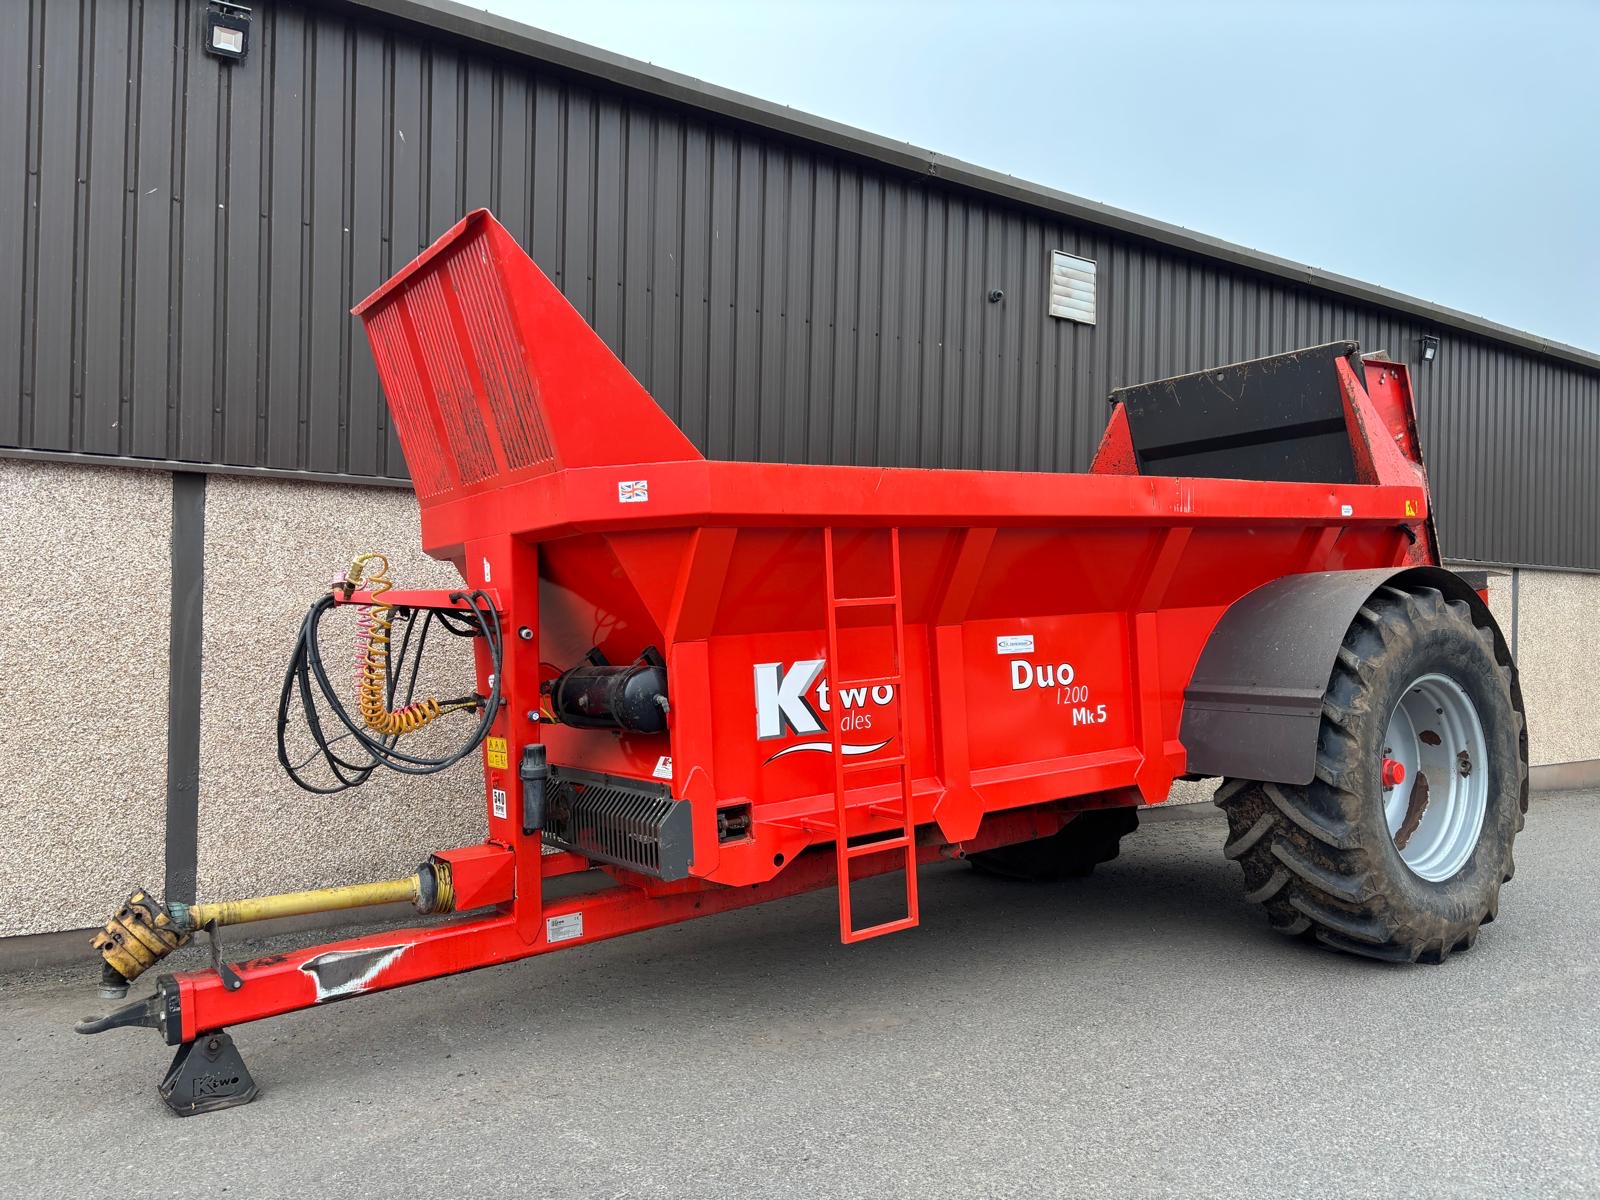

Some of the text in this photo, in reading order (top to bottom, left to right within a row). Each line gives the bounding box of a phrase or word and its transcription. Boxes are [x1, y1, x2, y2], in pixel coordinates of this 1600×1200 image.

[1010, 659, 1075, 691] Duo
[1057, 685, 1088, 705] 1200
[840, 710, 872, 732] ales
[494, 791, 505, 806] 540
